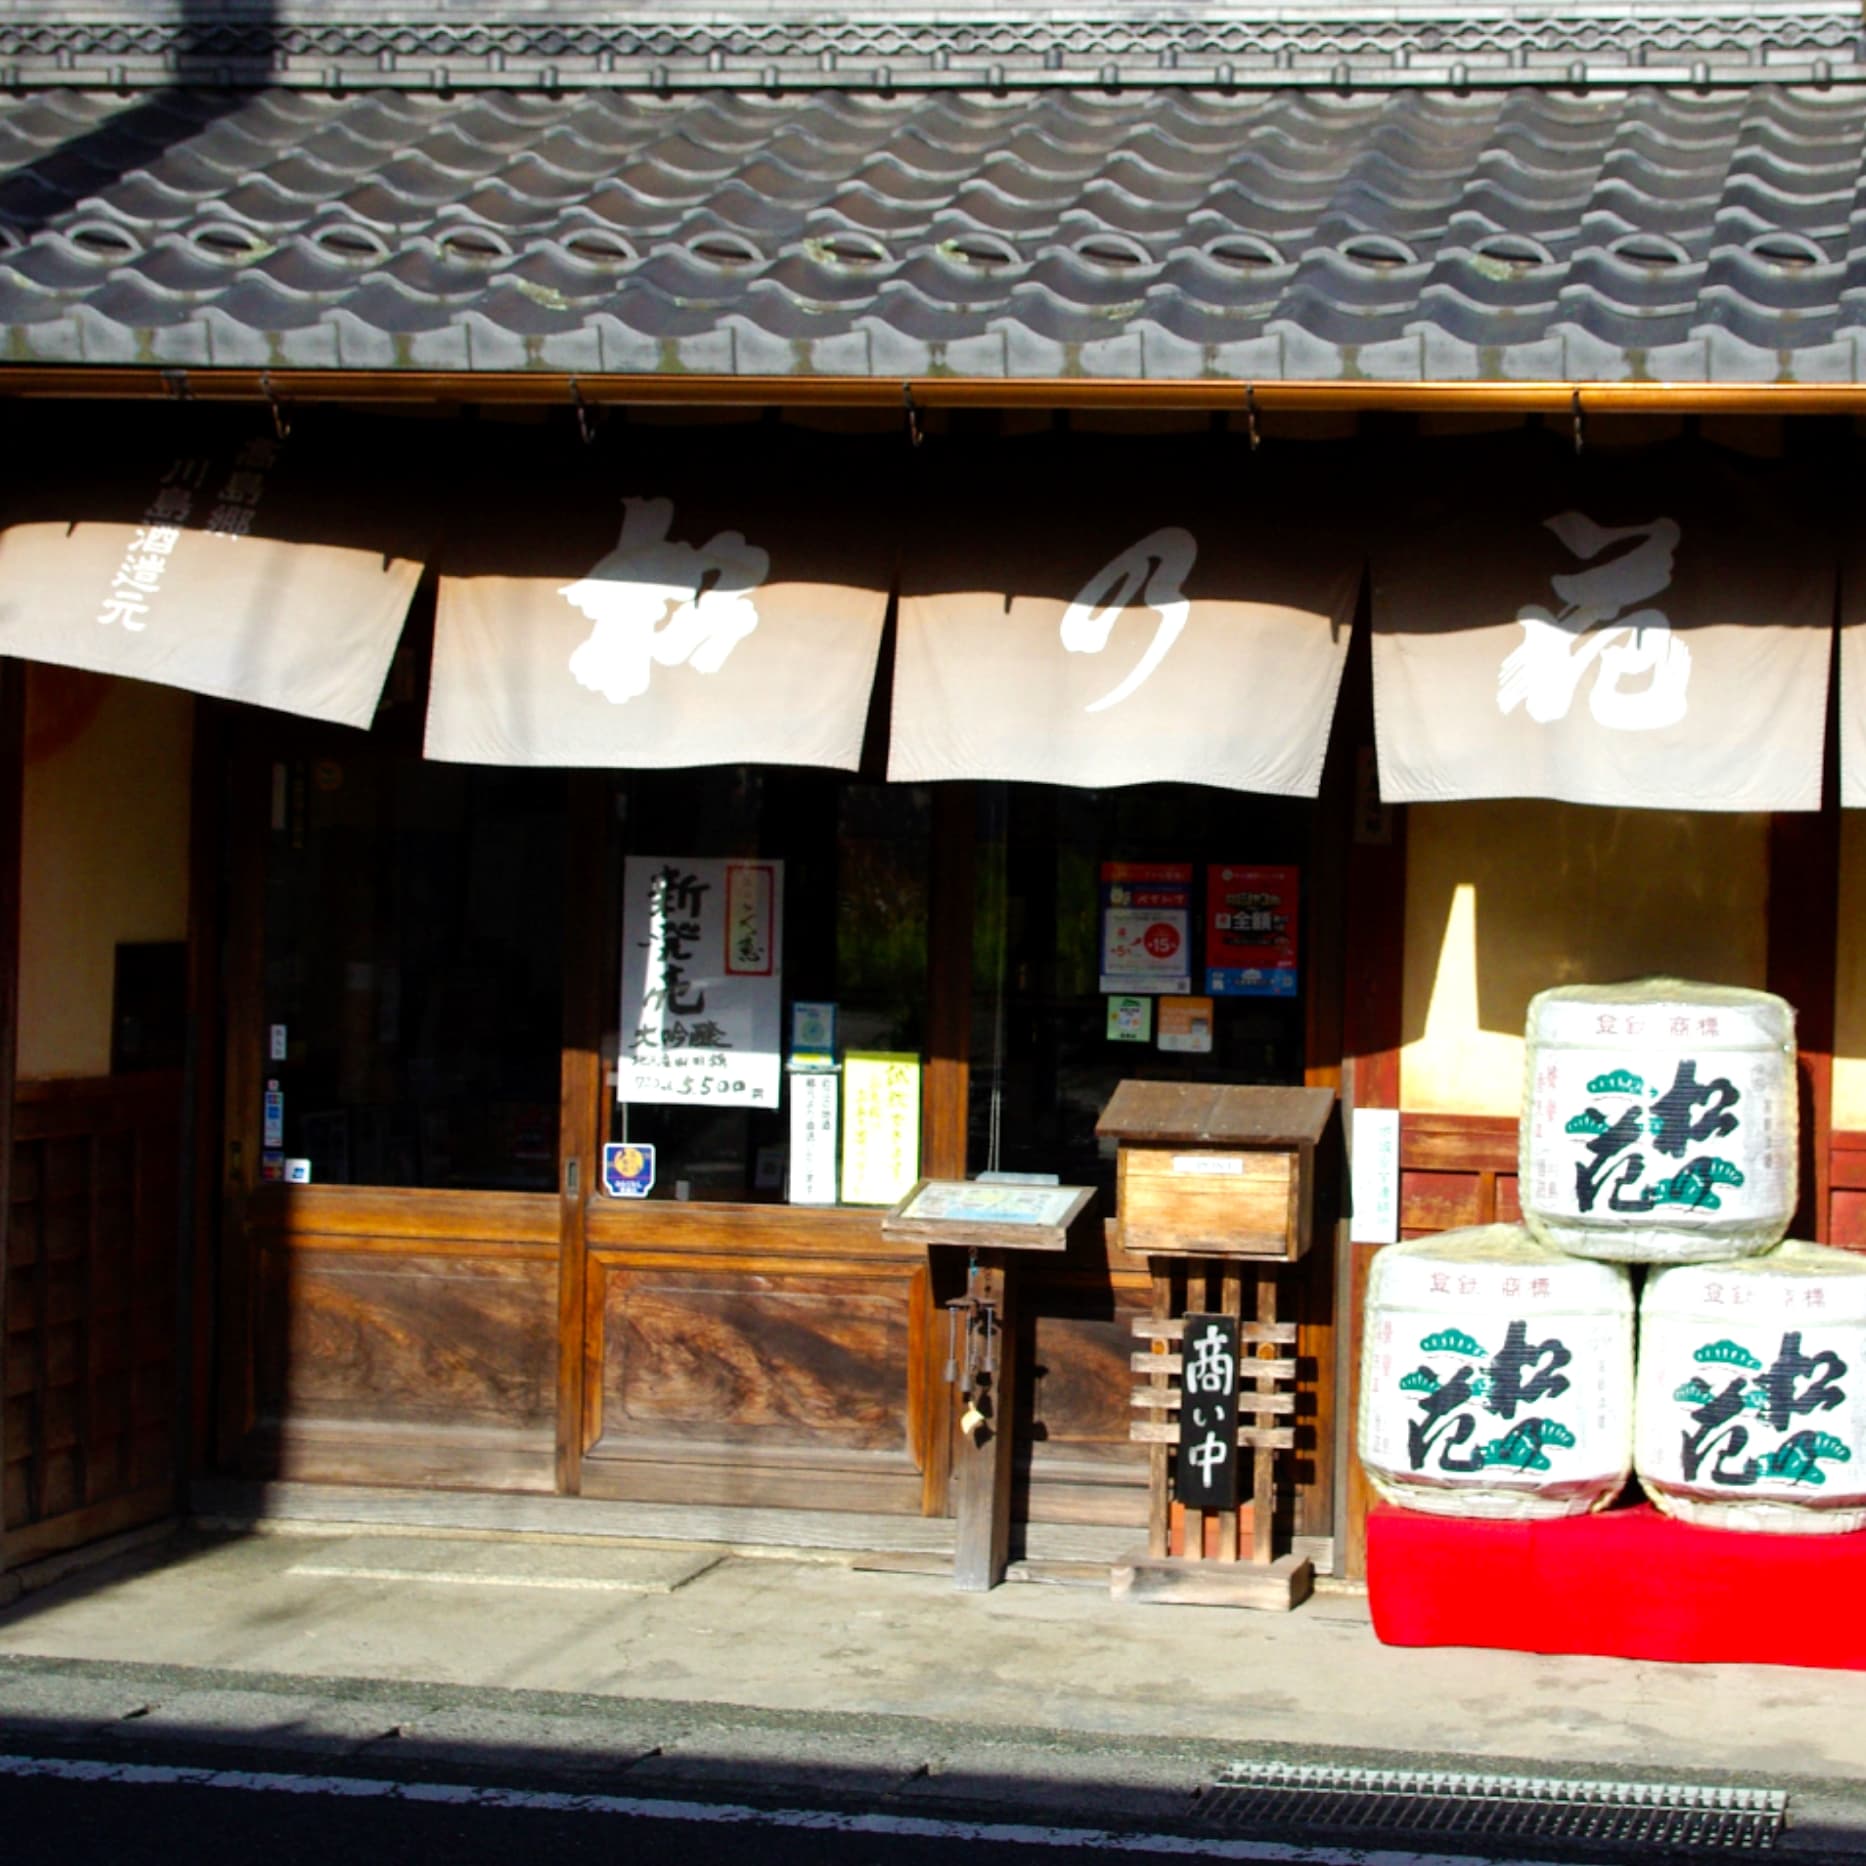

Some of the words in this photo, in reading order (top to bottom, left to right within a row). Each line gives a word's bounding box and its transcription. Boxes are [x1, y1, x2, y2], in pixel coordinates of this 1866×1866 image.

[1060, 527, 1197, 712] の
[1186, 1325, 1233, 1488] 商い中
